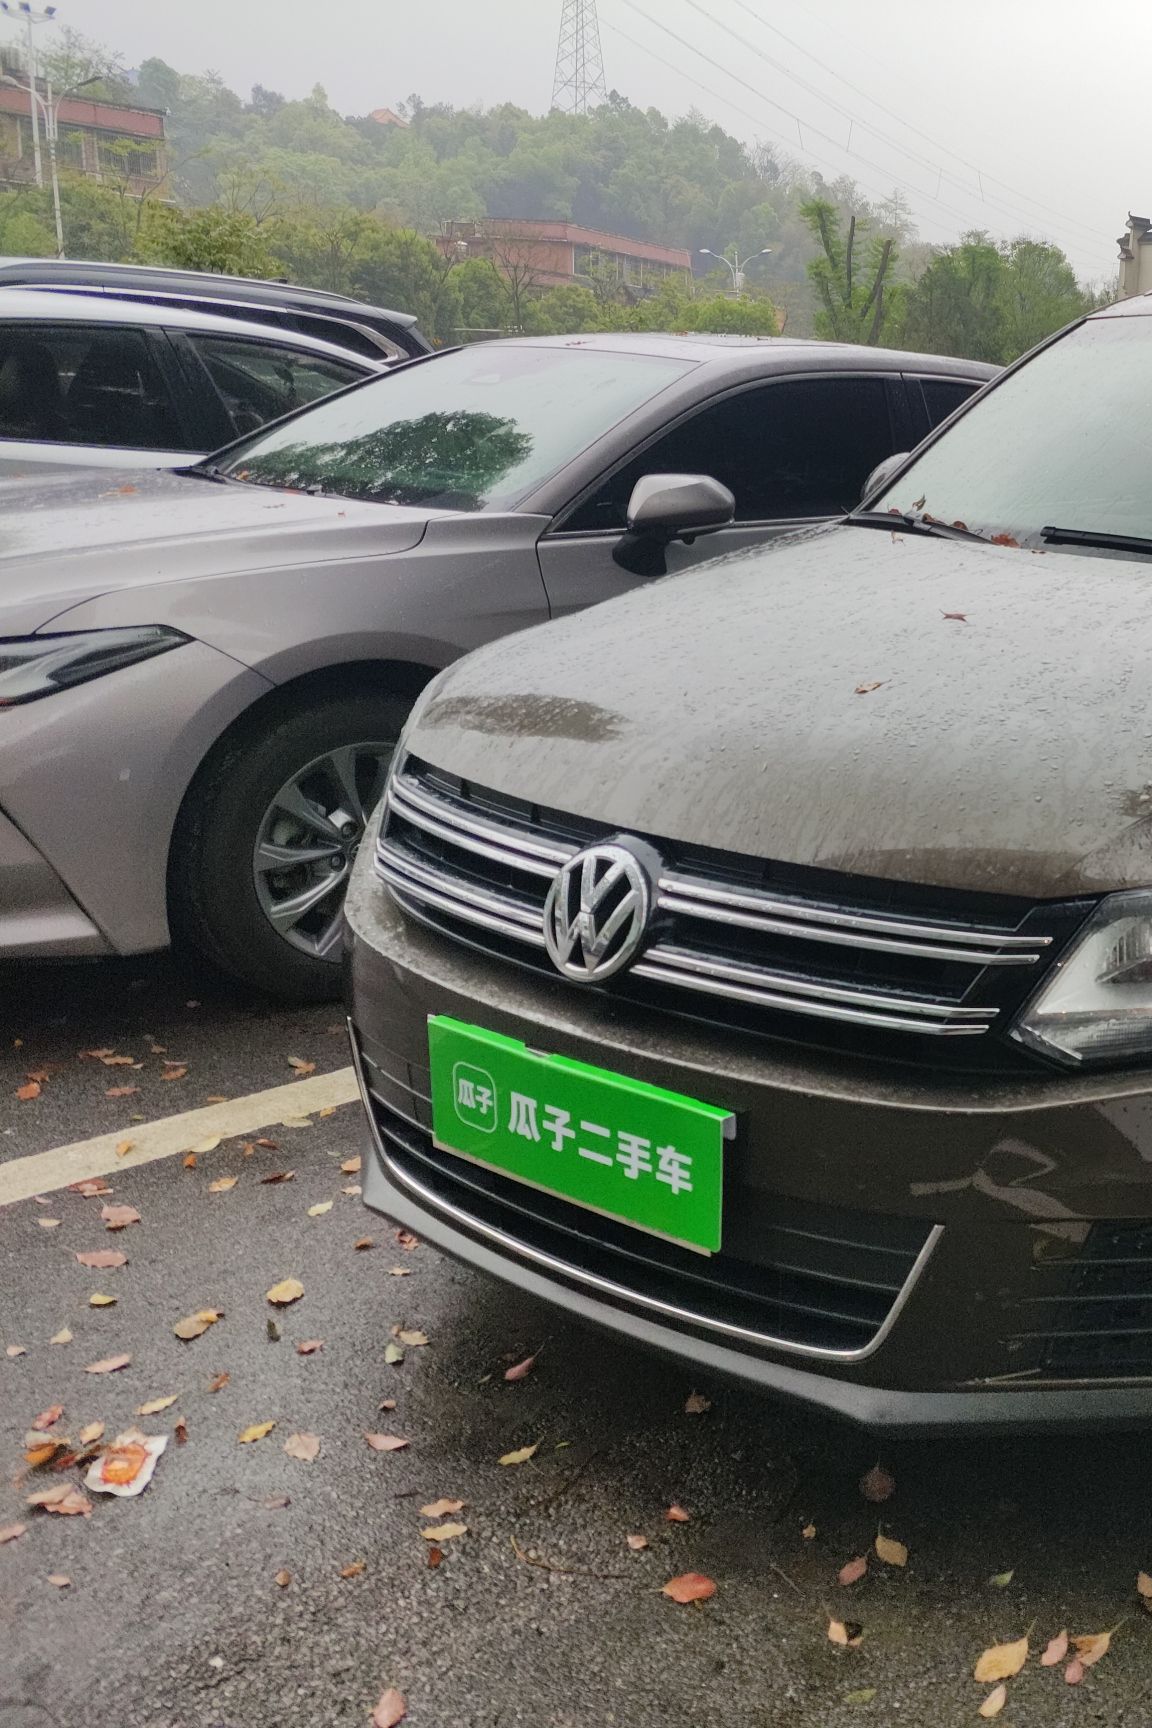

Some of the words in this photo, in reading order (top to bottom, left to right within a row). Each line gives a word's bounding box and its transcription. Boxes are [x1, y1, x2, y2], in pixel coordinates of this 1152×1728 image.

[458, 1079, 493, 1114] 瓜子
[508, 1091, 693, 1195] 瓜子二手车
